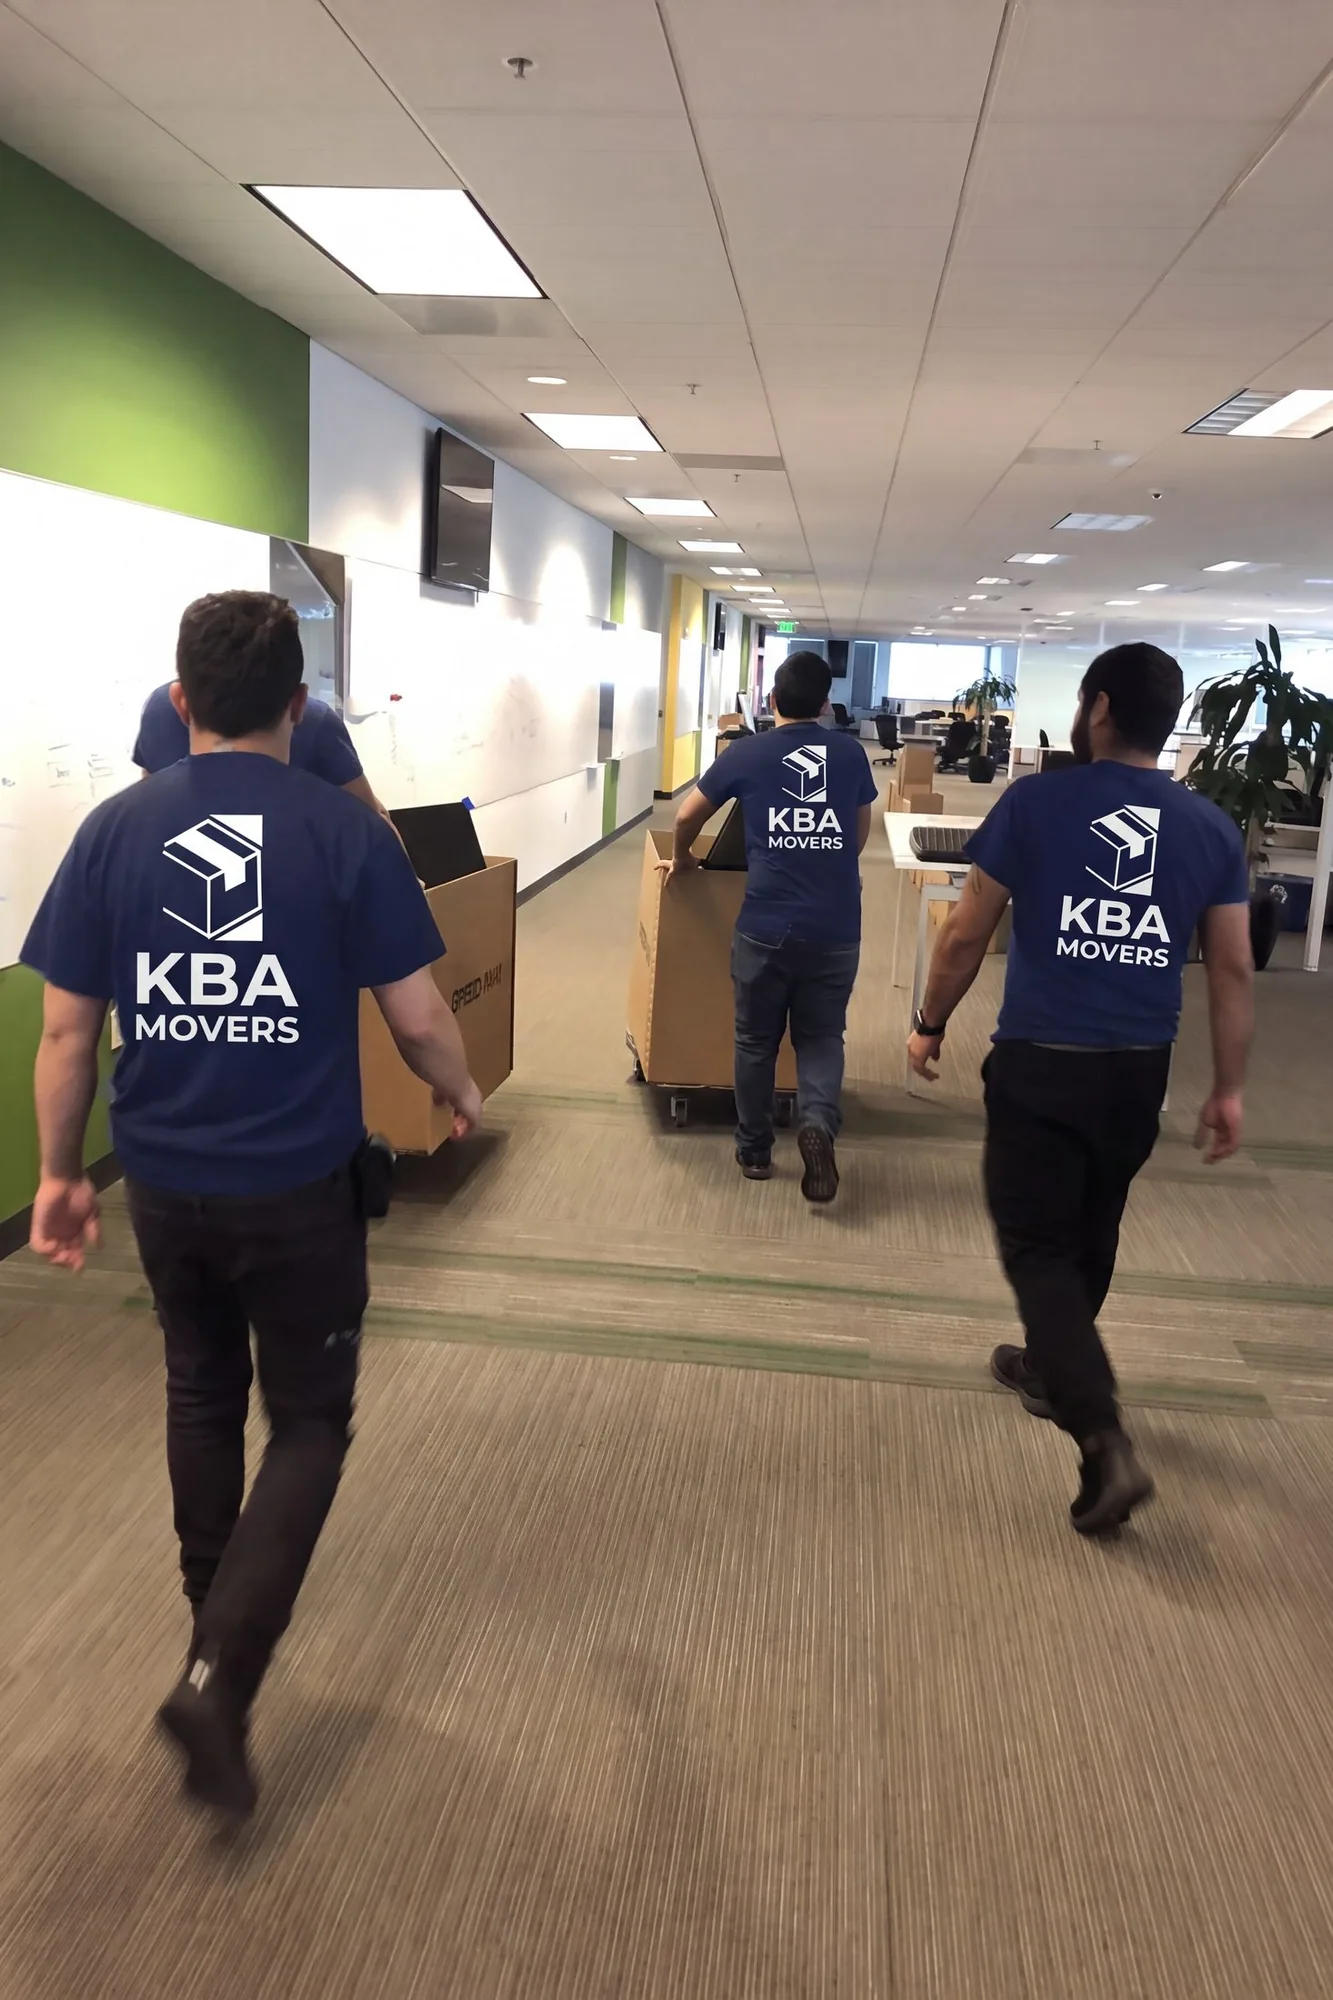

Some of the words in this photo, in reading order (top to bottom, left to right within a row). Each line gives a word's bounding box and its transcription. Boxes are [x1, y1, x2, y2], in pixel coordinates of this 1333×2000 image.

[768, 807, 843, 833] KBA
[768, 836, 843, 850] MOVERS
[1060, 895, 1171, 944] KBA
[1056, 937, 1169, 968] MOVERS
[136, 951, 299, 1007] KBA
[135, 1013, 300, 1044] MOVERS
